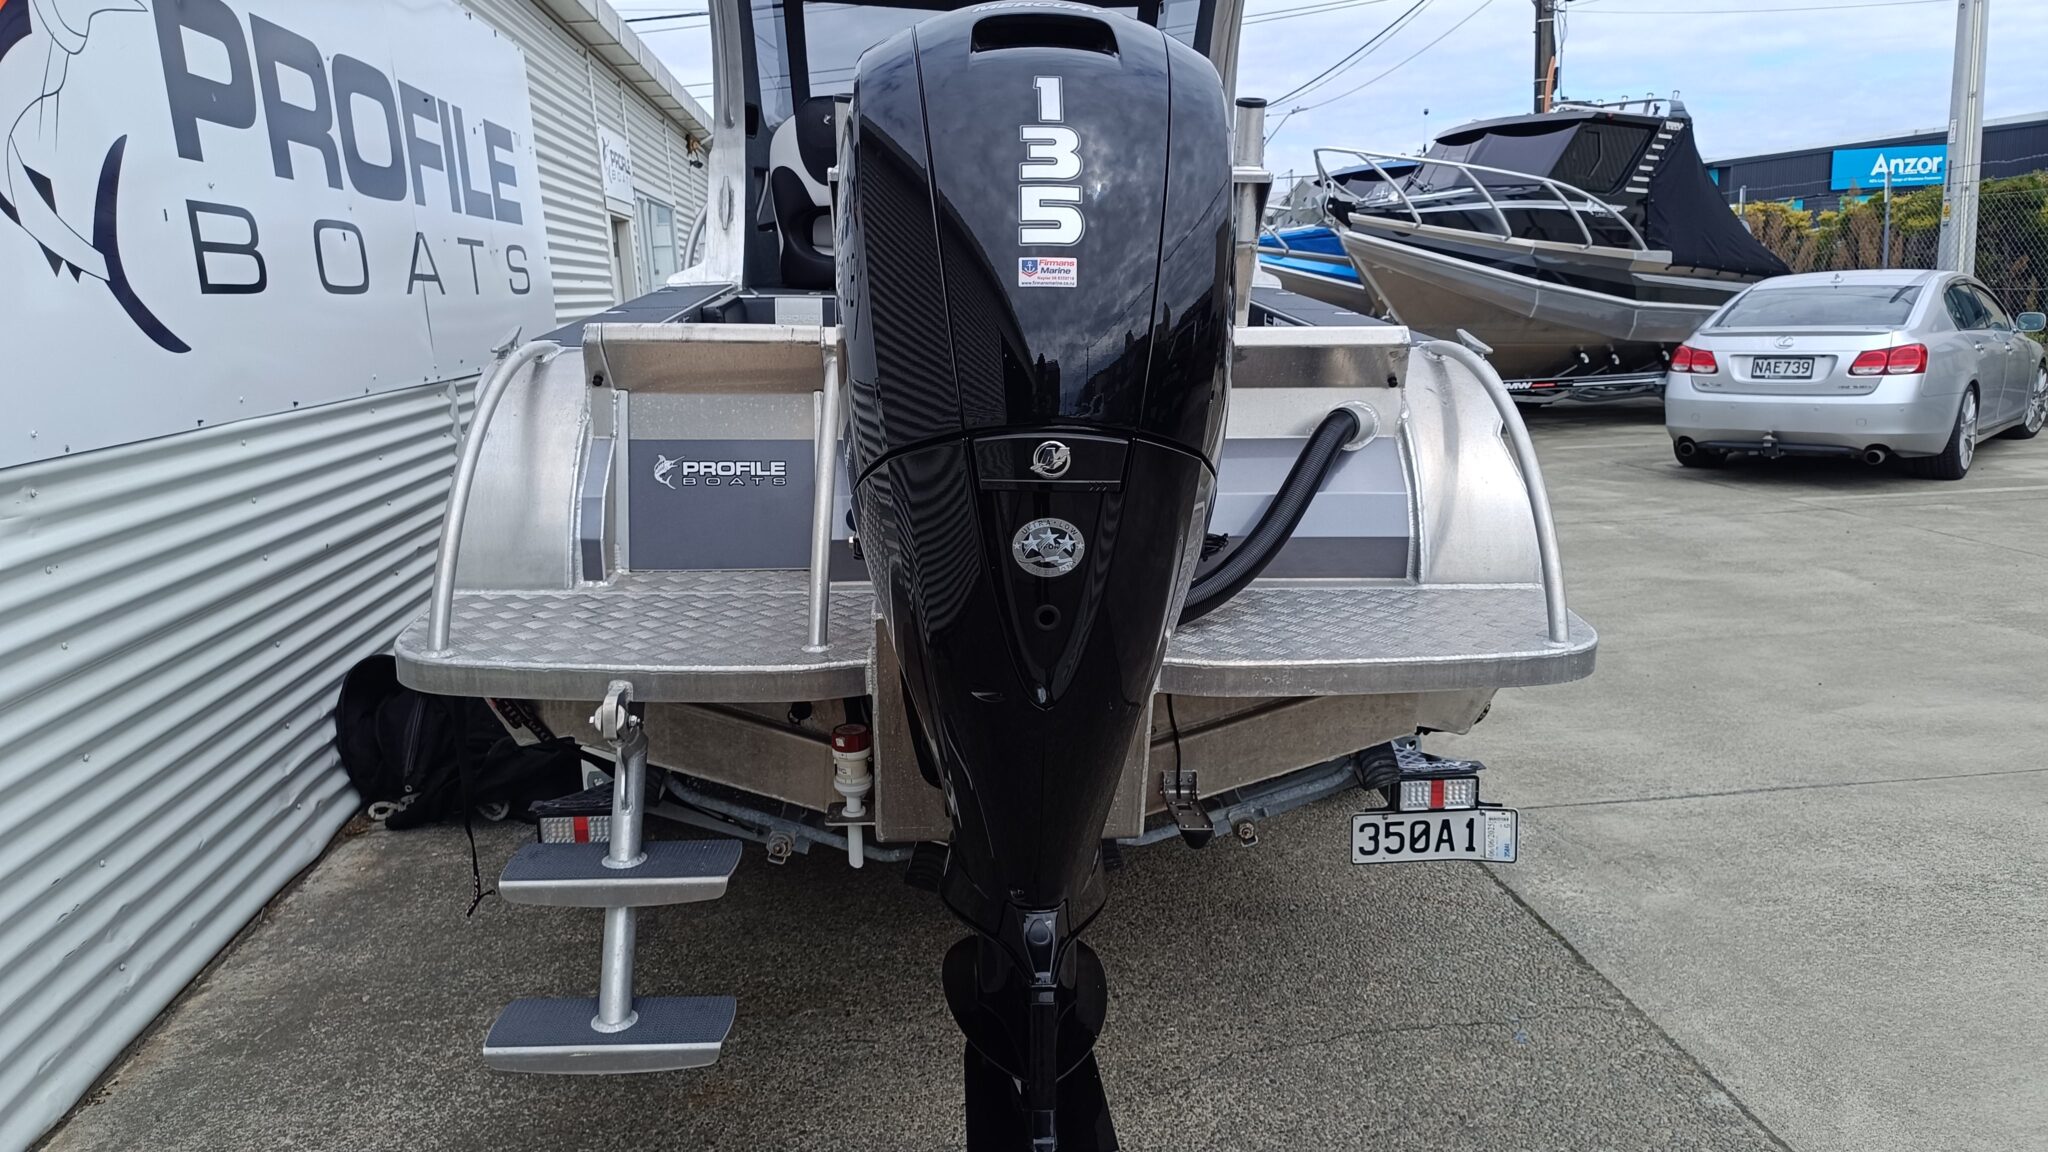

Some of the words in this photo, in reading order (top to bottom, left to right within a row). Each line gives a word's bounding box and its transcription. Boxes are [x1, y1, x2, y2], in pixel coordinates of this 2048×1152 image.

[151, 0, 524, 226] PROFILE
[1870, 153, 1943, 176] Anzor
[186, 199, 531, 295] BOATS
[1039, 259, 1075, 267] Firmans
[1754, 361, 1810, 374] NAE739
[682, 461, 786, 476] PROFILE
[682, 477, 787, 486] BOATS
[1059, 523, 1078, 536] LOW
[1358, 817, 1477, 856] 350A1
